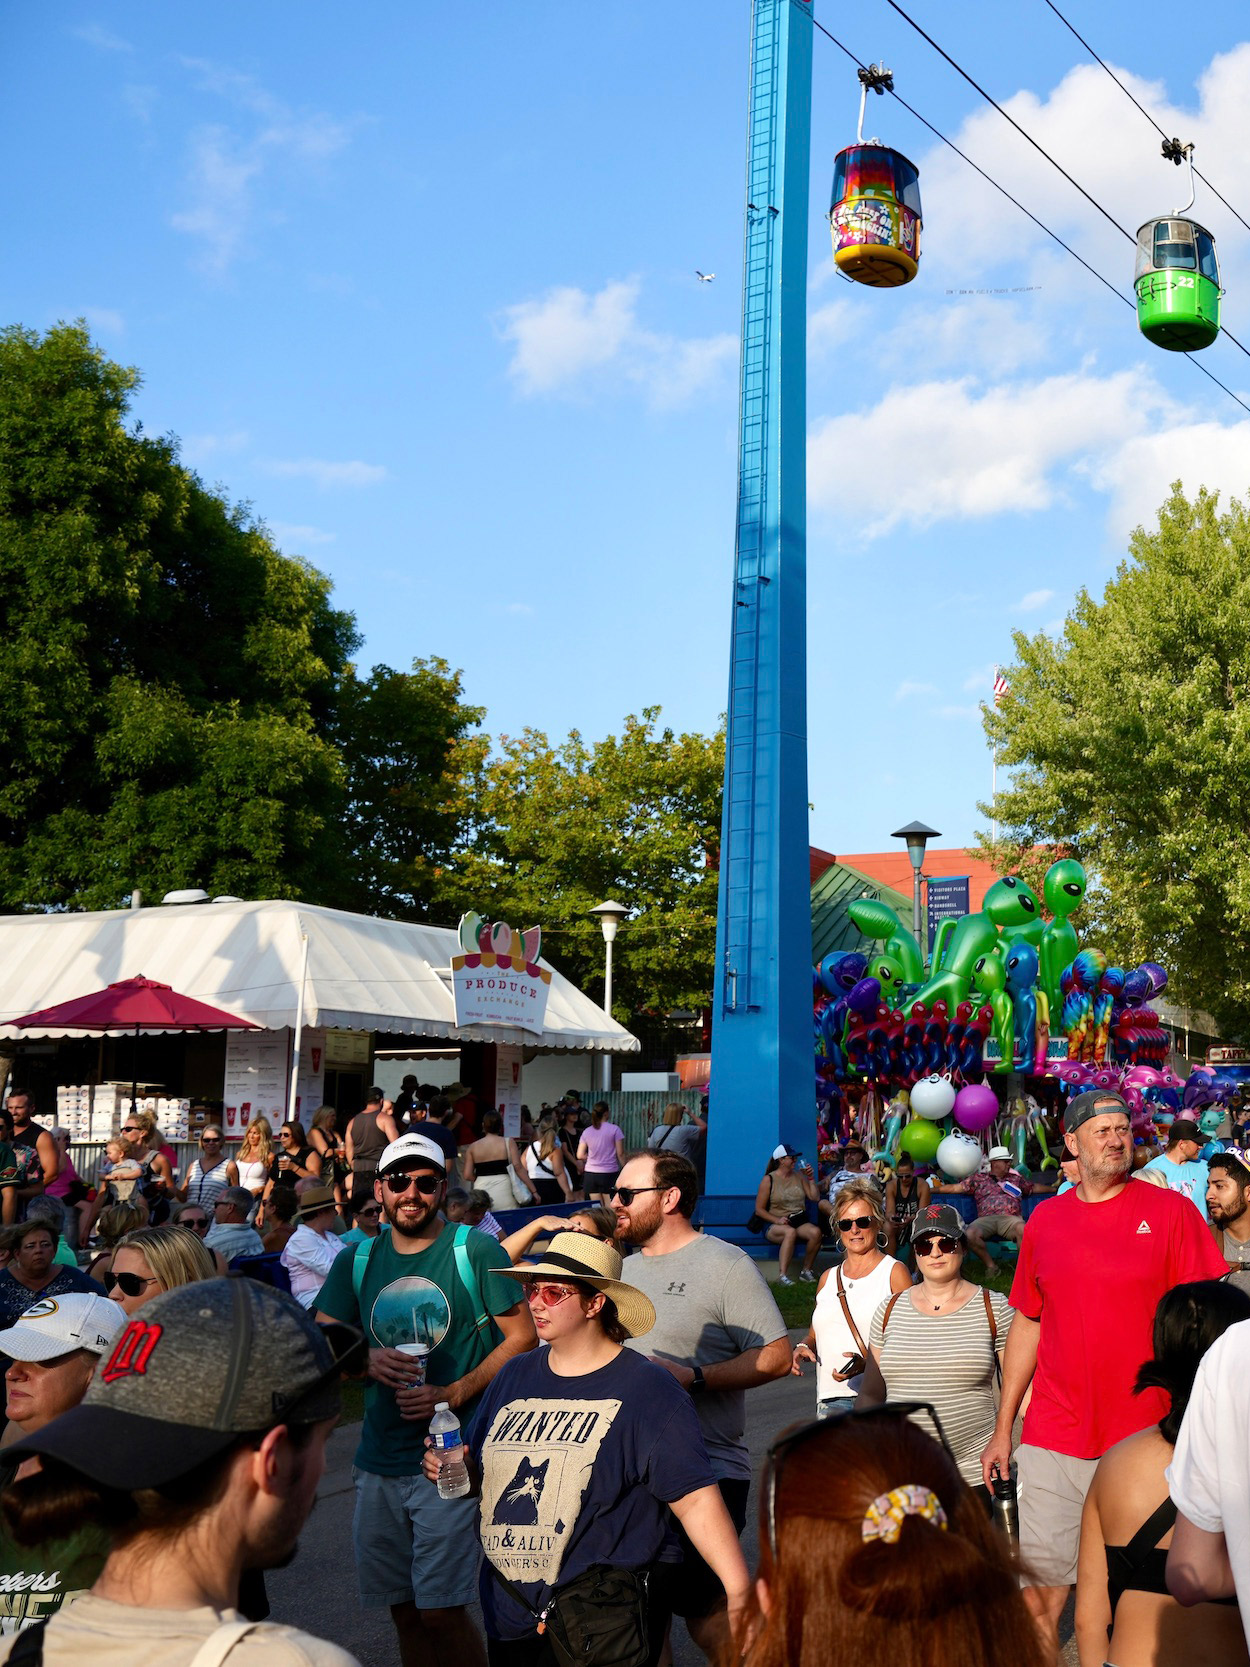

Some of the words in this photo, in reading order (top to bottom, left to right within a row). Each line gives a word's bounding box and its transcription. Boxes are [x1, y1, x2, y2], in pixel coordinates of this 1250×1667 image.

[1178, 276, 1194, 288] 22
[465, 979, 537, 998] PRODUCE
[477, 996, 525, 1007] EXCHANGE
[491, 1410, 600, 1443] WANTED
[501, 1528, 517, 1548] &
[516, 1535, 557, 1551] ALIV
